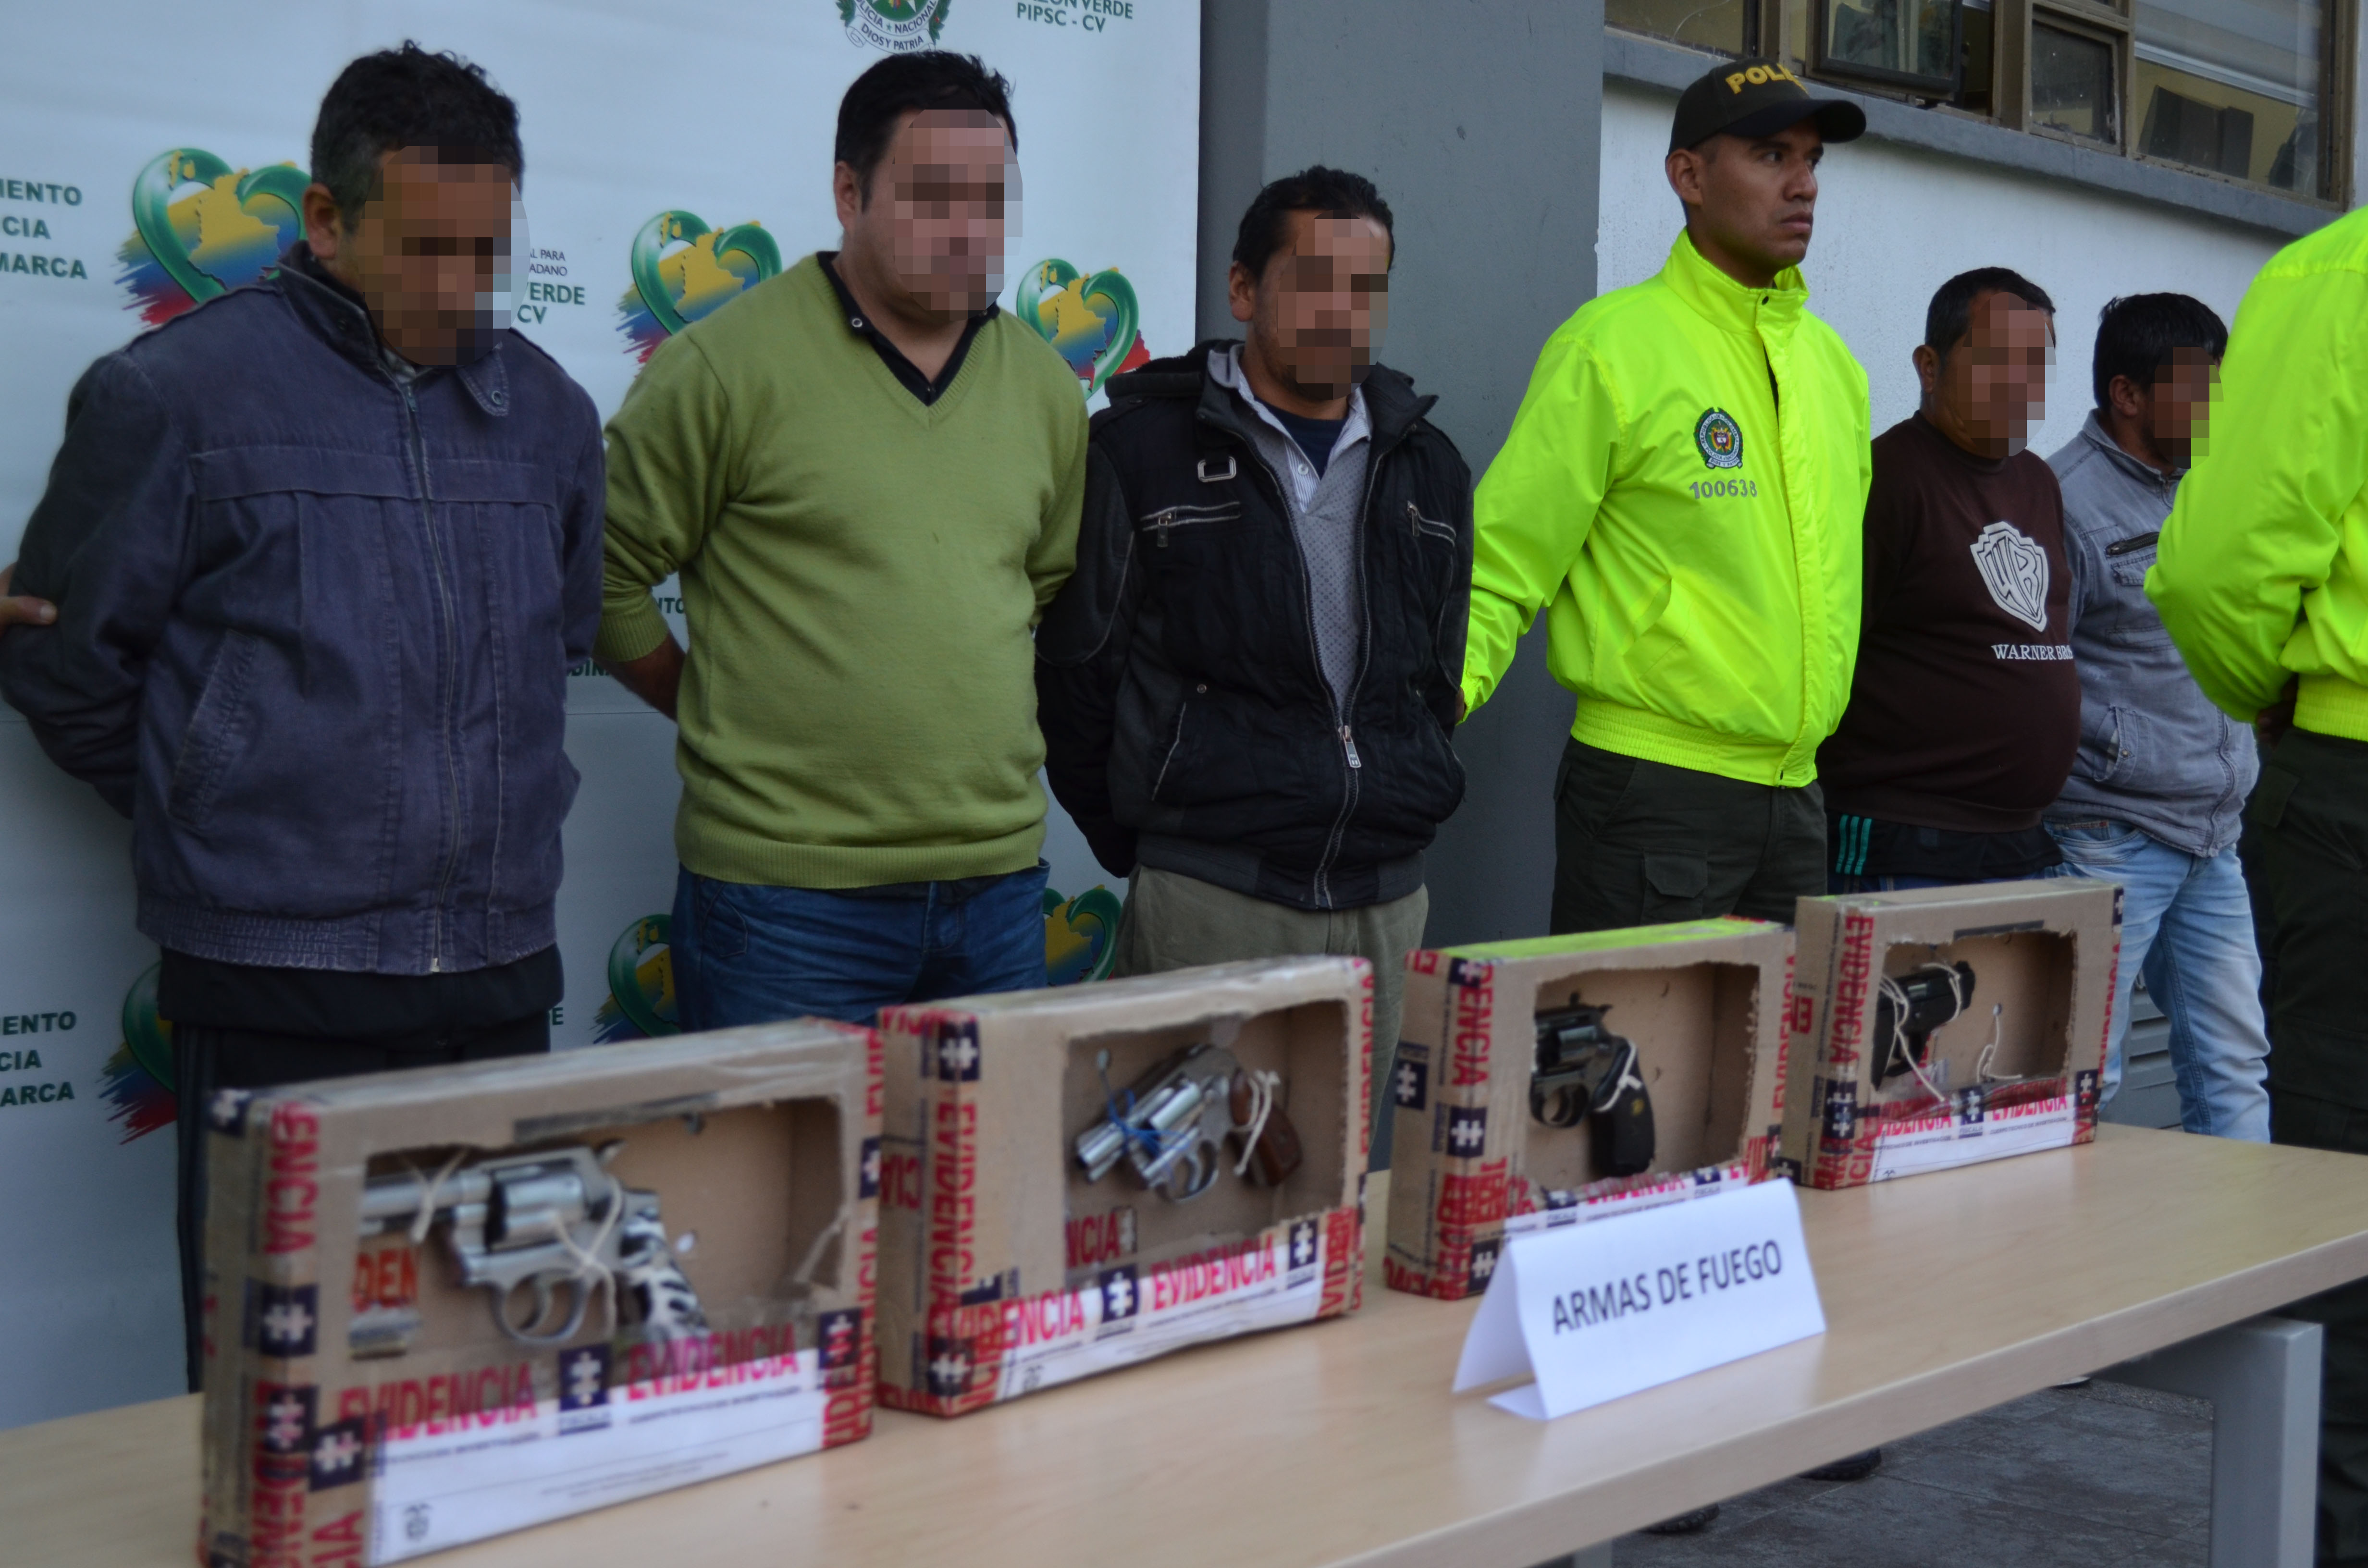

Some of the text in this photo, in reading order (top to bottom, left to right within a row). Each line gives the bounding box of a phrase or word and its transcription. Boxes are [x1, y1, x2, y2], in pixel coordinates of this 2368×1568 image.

[895, 0, 937, 34] NACIONAL
[1017, 2, 1067, 26] PIPSC
[1082, 15, 1105, 33] CV
[861, 24, 886, 45] DIOS
[894, 36, 924, 50] PATRIA
[1725, 63, 1810, 95] POLI
[0, 178, 82, 206] ENTO
[2, 216, 51, 239] CIA
[540, 249, 566, 261] PARA
[527, 282, 585, 306] ERDE
[1689, 479, 1758, 499] 100638
[1991, 644, 2057, 660] WARNER
[1829, 915, 1874, 1065] EVIDENCIA
[0, 1011, 77, 1035] ENTO
[1065, 1211, 1122, 1269] NCIA
[1150, 1234, 1275, 1311] EVIDENCIA
[1553, 1240, 1782, 1335] ARMAS DE FUEGO
[627, 1323, 800, 1401] EVIDENCIA
